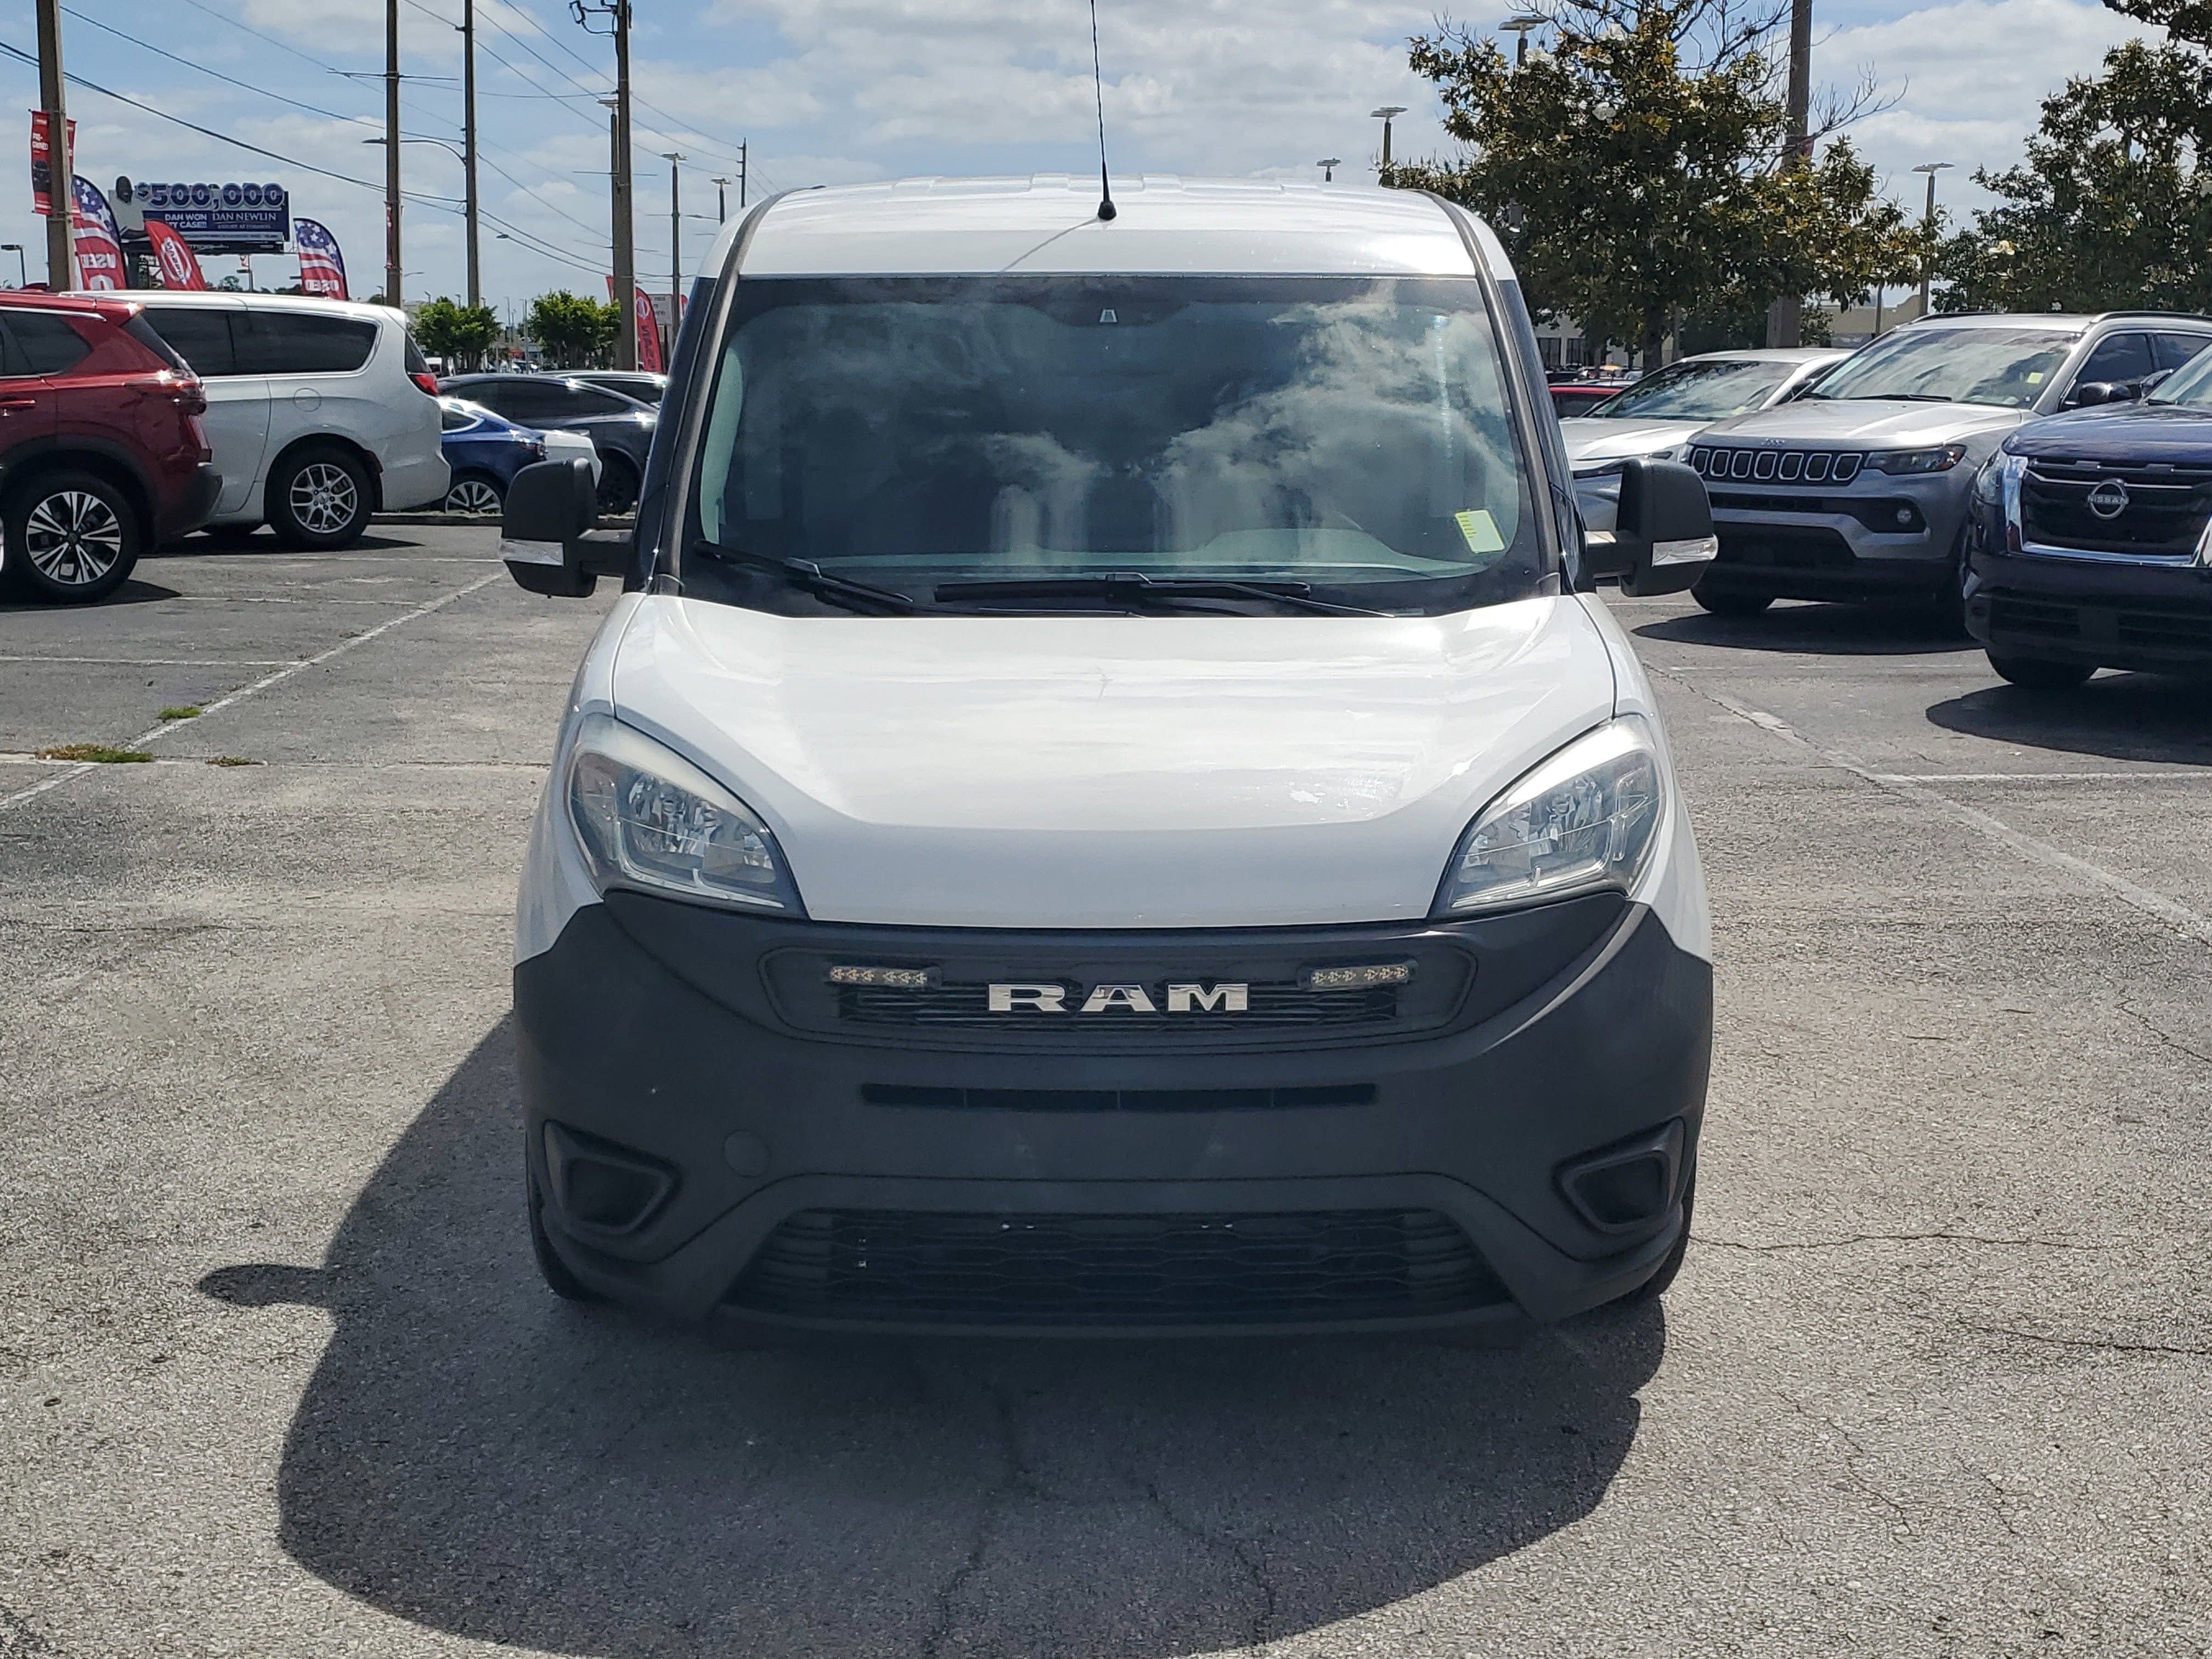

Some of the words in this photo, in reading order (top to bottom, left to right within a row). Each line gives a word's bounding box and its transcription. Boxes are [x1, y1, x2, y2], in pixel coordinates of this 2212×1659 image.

[137, 183, 284, 210] $500,000
[212, 212, 234, 221] DAN
[235, 212, 276, 221] NEWLIN
[2087, 495, 2129, 504] NISSAN
[988, 984, 1248, 1012] RAM
